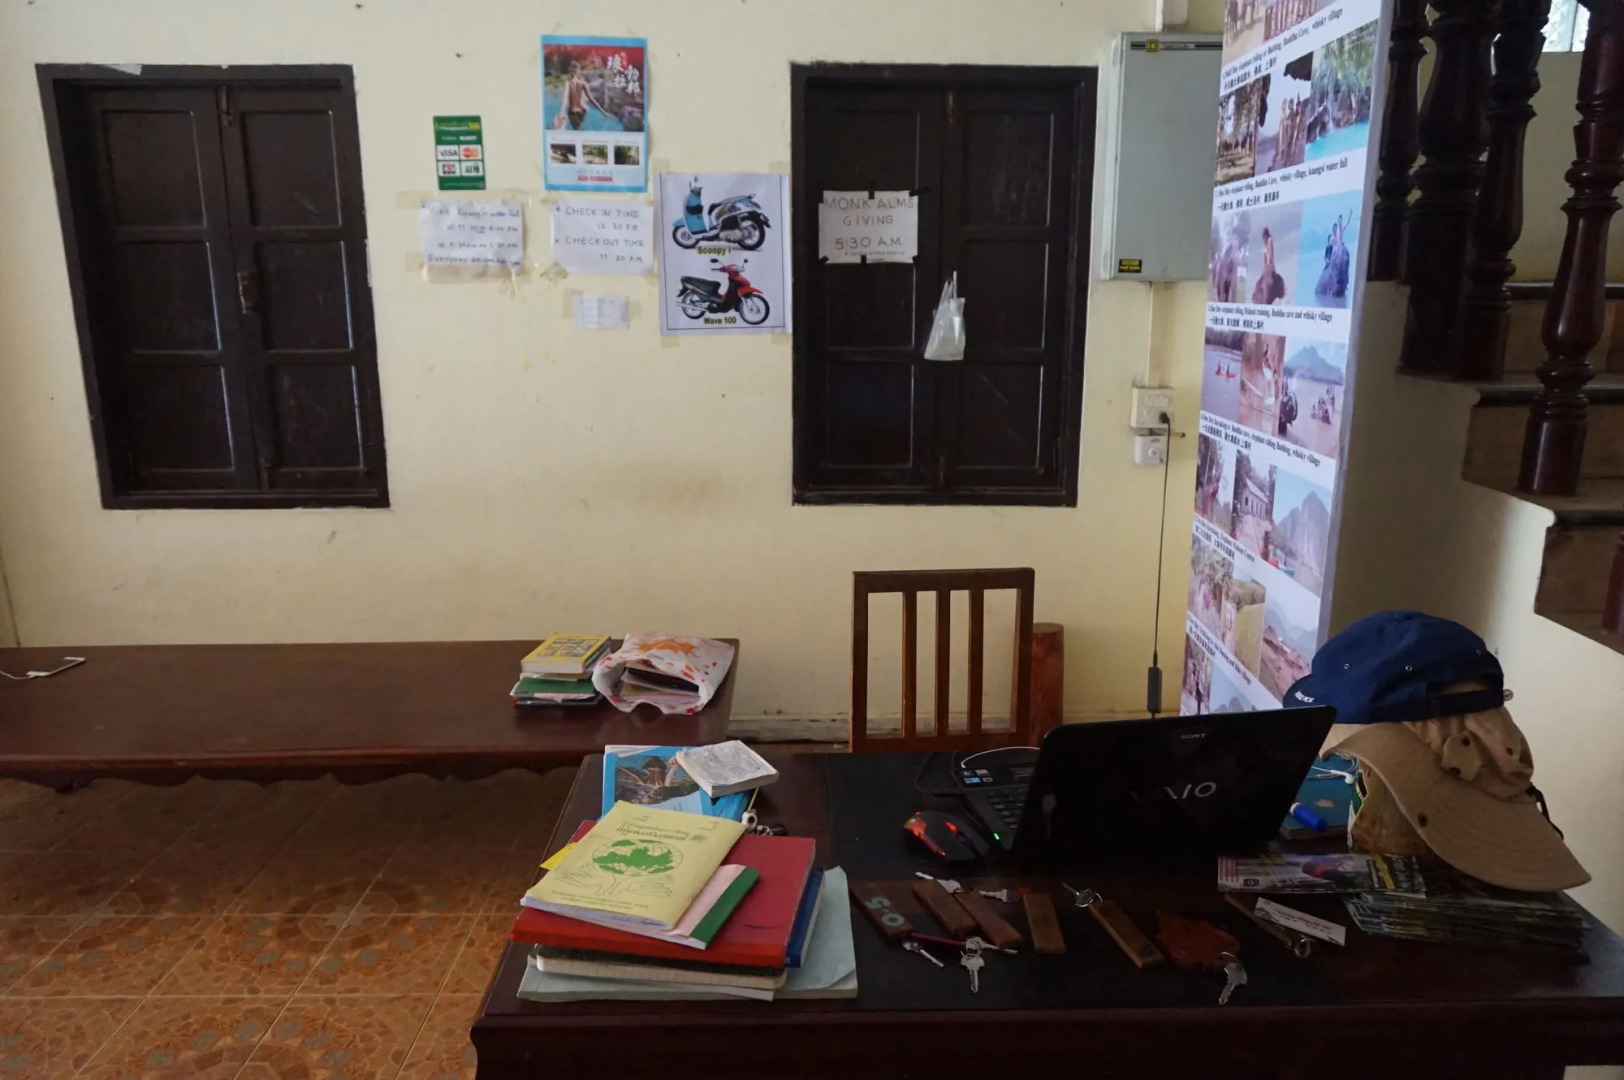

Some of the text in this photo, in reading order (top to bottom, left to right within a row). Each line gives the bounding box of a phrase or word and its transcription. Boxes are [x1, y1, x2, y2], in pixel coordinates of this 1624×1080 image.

[440, 148, 458, 157] VISA
[825, 196, 914, 210] MONK ALMS
[565, 206, 639, 218] CHECK IN TIME
[843, 214, 893, 226] GIVING
[565, 236, 644, 247] CHECK OUT TIME
[835, 235, 871, 250] 5:30
[697, 245, 727, 256] Scoopy
[703, 316, 737, 325] Wave 100
